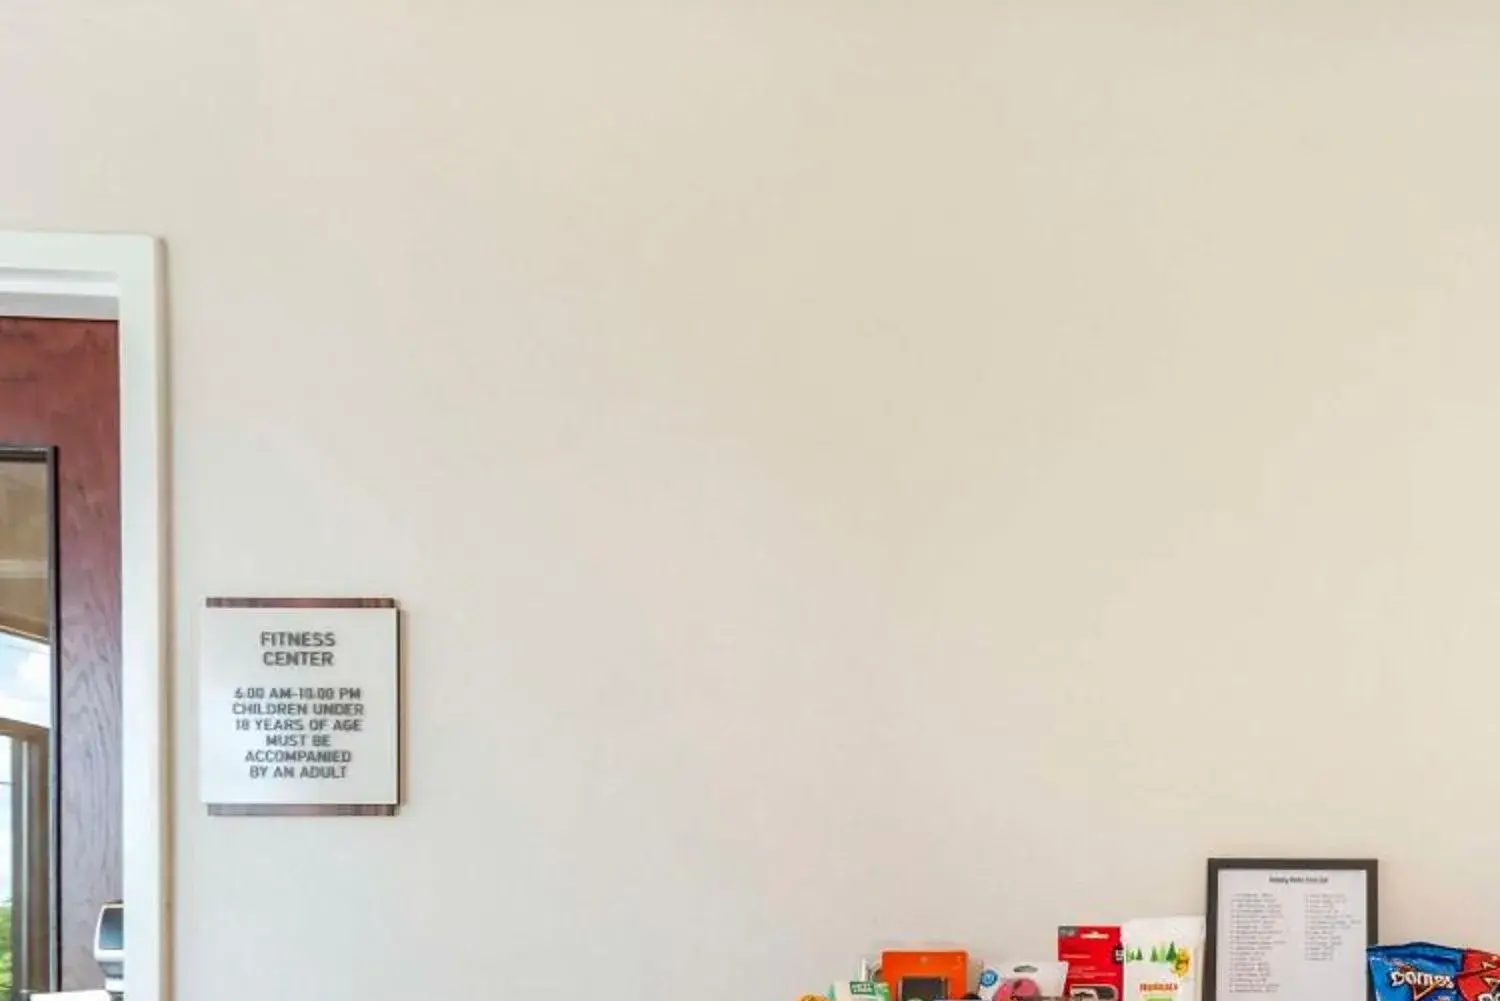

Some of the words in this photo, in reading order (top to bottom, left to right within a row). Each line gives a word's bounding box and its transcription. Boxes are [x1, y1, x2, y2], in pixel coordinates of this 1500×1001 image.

[260, 631, 336, 647] FITNESS
[263, 651, 335, 667] CENTER
[339, 687, 361, 700] PM
[232, 703, 308, 716] CHILDREN
[313, 703, 364, 716] UNDER
[255, 719, 304, 731] YEARS
[309, 719, 328, 731] OF
[333, 719, 363, 731] AGE
[265, 735, 307, 747] MUST
[312, 735, 331, 747] BE
[244, 750, 352, 763] ACCOMPANIED
[249, 766, 269, 779] BY
[273, 766, 295, 779] AN
[300, 766, 347, 779] ADULT
